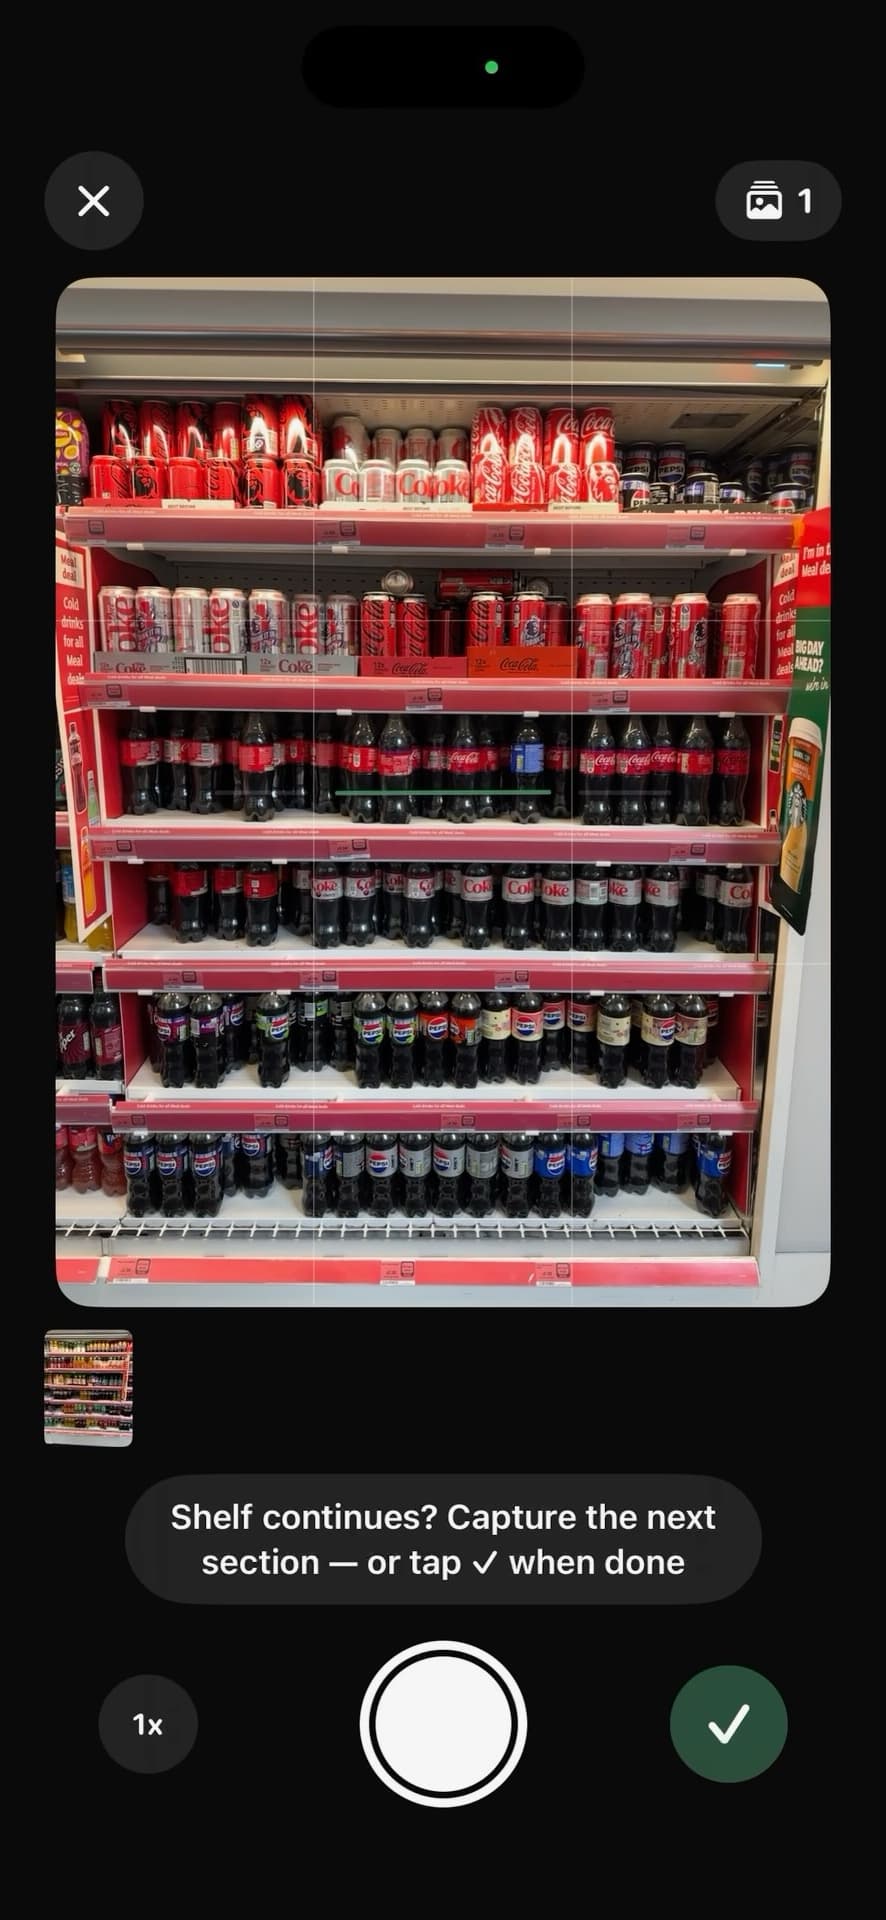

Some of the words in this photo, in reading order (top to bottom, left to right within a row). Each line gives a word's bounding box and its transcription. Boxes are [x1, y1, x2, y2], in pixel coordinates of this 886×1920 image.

[803, 547, 815, 560] I'm
[816, 544, 825, 558] in
[61, 553, 77, 568] Meal
[62, 568, 77, 581] deal
[802, 562, 818, 577] Meal
[63, 597, 80, 611] Cold
[779, 590, 795, 606] Cold
[61, 615, 84, 630] drinks
[776, 608, 797, 624] drinks
[776, 629, 786, 641] for
[786, 625, 796, 639] all
[64, 635, 74, 648] for
[75, 636, 84, 648] all
[795, 640, 807, 655] BIG
[808, 641, 824, 657] DAY
[777, 644, 794, 658] Meal
[66, 655, 83, 667] Meal
[116, 662, 146, 673] Coke
[279, 659, 314, 674] Coke
[795, 656, 824, 673] AHEAD?
[776, 662, 794, 676] deals
[516, 1022, 536, 1030] PEPSI
[370, 1160, 388, 1168] PEPSI
